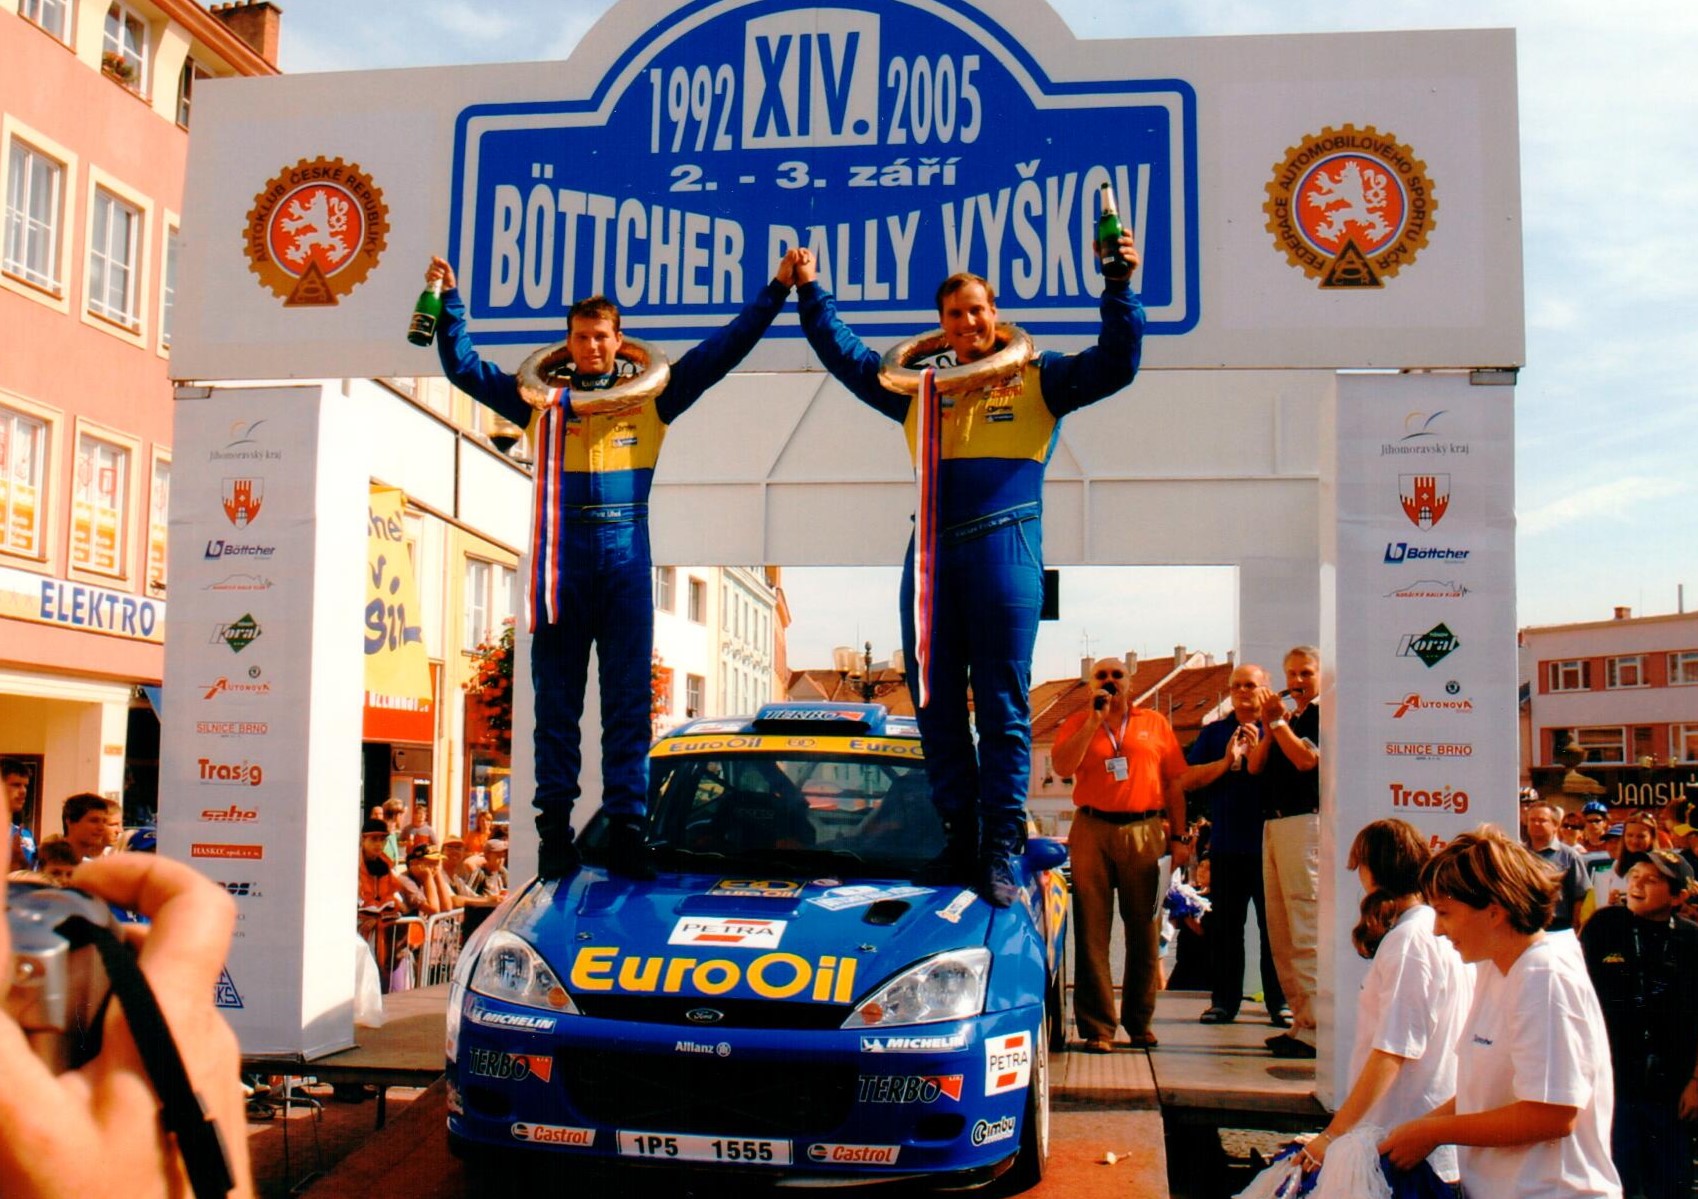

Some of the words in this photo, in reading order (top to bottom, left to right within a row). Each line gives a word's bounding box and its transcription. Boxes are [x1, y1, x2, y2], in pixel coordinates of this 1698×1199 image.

[650, 63, 735, 154] 1992
[752, 32, 870, 138] XIV.
[886, 54, 982, 144] 2005
[669, 164, 718, 192] 2.
[775, 161, 827, 189] 3.
[848, 157, 963, 187] září
[252, 184, 287, 263] AUTOKLUB
[289, 166, 344, 185] ČESKÉ
[344, 174, 381, 259] REPUBLIKY
[1407, 176, 1427, 242] SPORTU
[488, 162, 745, 307] BÖTTCHER
[767, 211, 919, 303] RALLY
[942, 160, 1152, 300] VYŠKOV
[223, 544, 276, 556] Böttcher
[1406, 547, 1470, 559] Böttcher
[40, 580, 156, 637] ELEKTRO
[196, 723, 236, 734] SILNICE
[239, 724, 268, 735] BRNO
[1386, 744, 1432, 756] SILNICE
[1437, 745, 1473, 756] BRNO
[198, 758, 263, 786] Trasig
[1389, 783, 1469, 814] Trasig
[681, 921, 776, 938] PETRA
[570, 946, 858, 1003] EuroOil
[482, 1012, 555, 1030] MICHELIN
[675, 1040, 714, 1054] Allianz
[885, 1035, 966, 1050] MICHELIN
[469, 1047, 531, 1082] TERBO
[989, 1051, 1029, 1073] PETRA
[858, 1075, 943, 1104] TERBO
[533, 1125, 589, 1145] Castrol
[634, 1135, 680, 1157] 1P5
[711, 1139, 774, 1162] 1555
[832, 1145, 893, 1163] Castrol
